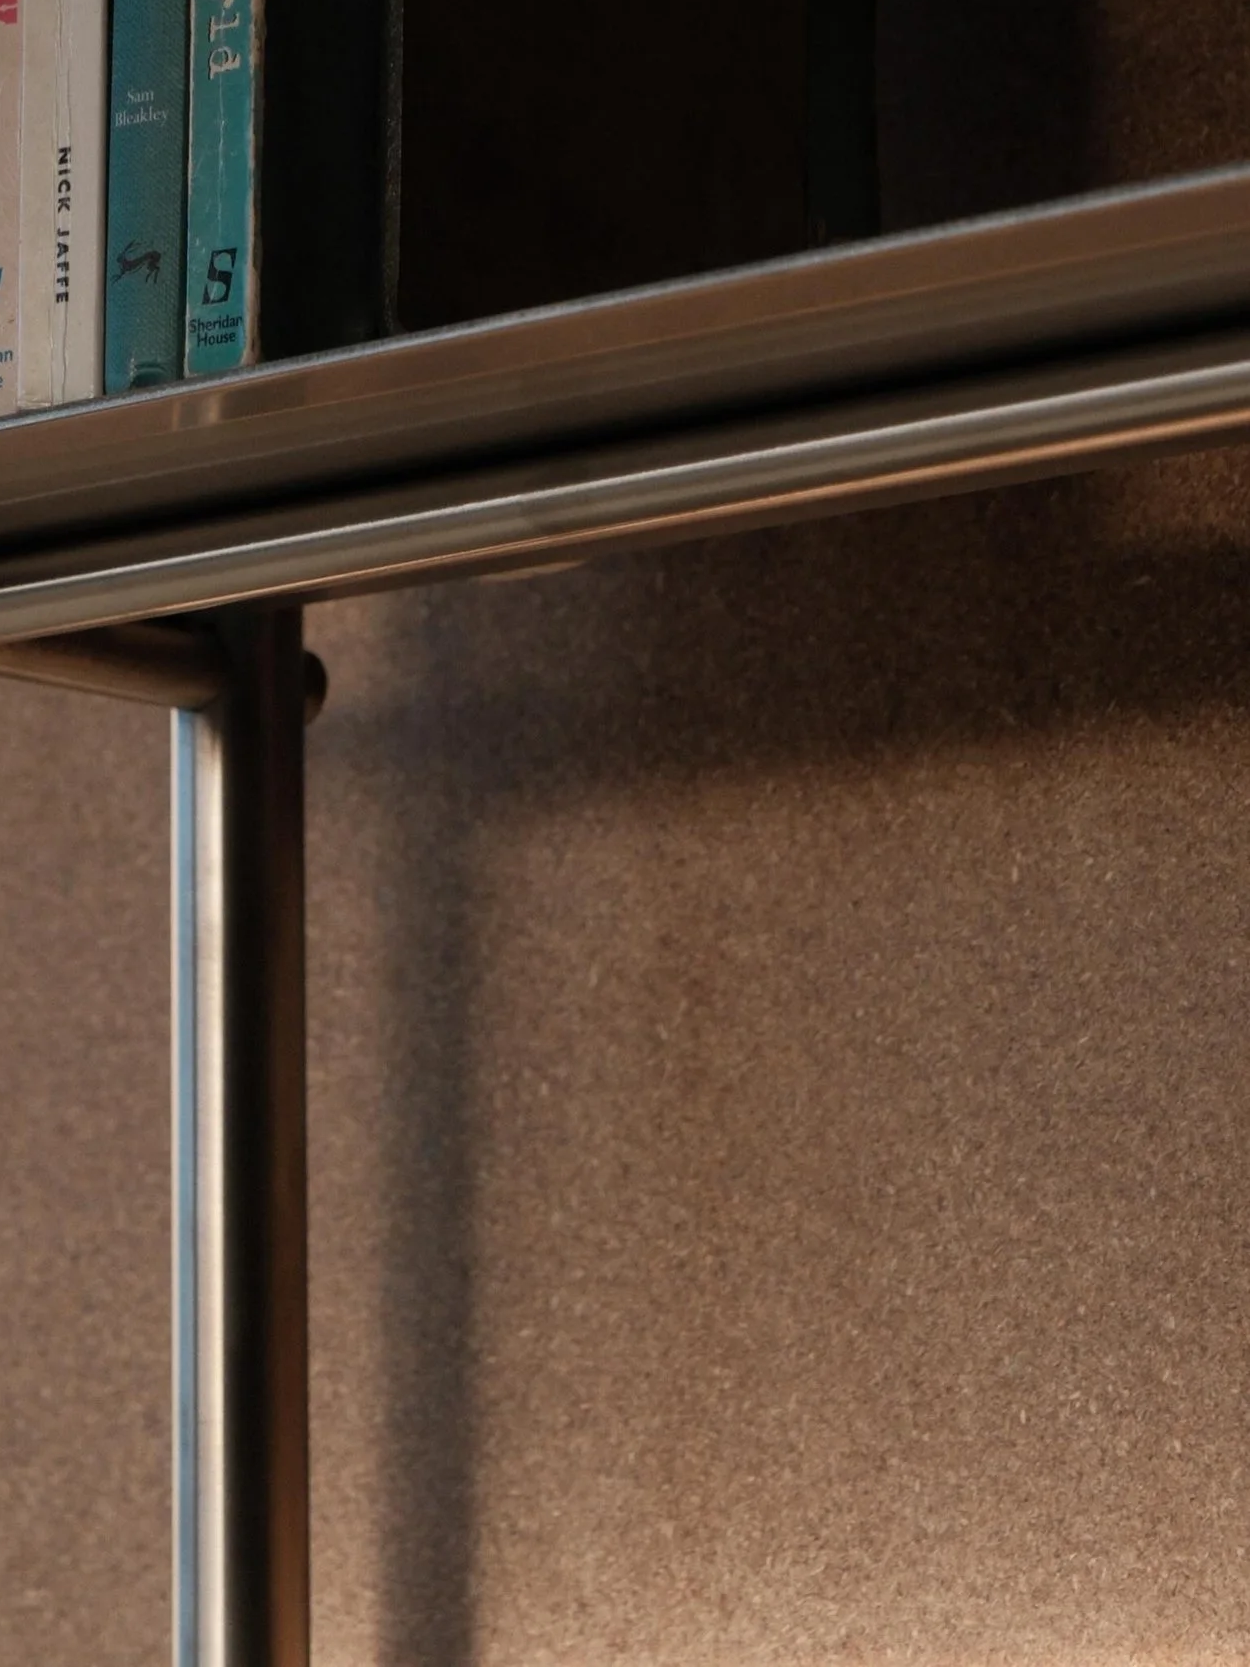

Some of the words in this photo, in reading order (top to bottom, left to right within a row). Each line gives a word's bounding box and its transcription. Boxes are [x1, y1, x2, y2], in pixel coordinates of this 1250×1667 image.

[126, 88, 155, 104] Sam
[114, 106, 169, 127] Bleakley
[56, 146, 72, 214] NICK
[55, 227, 70, 304] JAFFE
[190, 315, 243, 334] Sheridan
[197, 332, 236, 348] House
